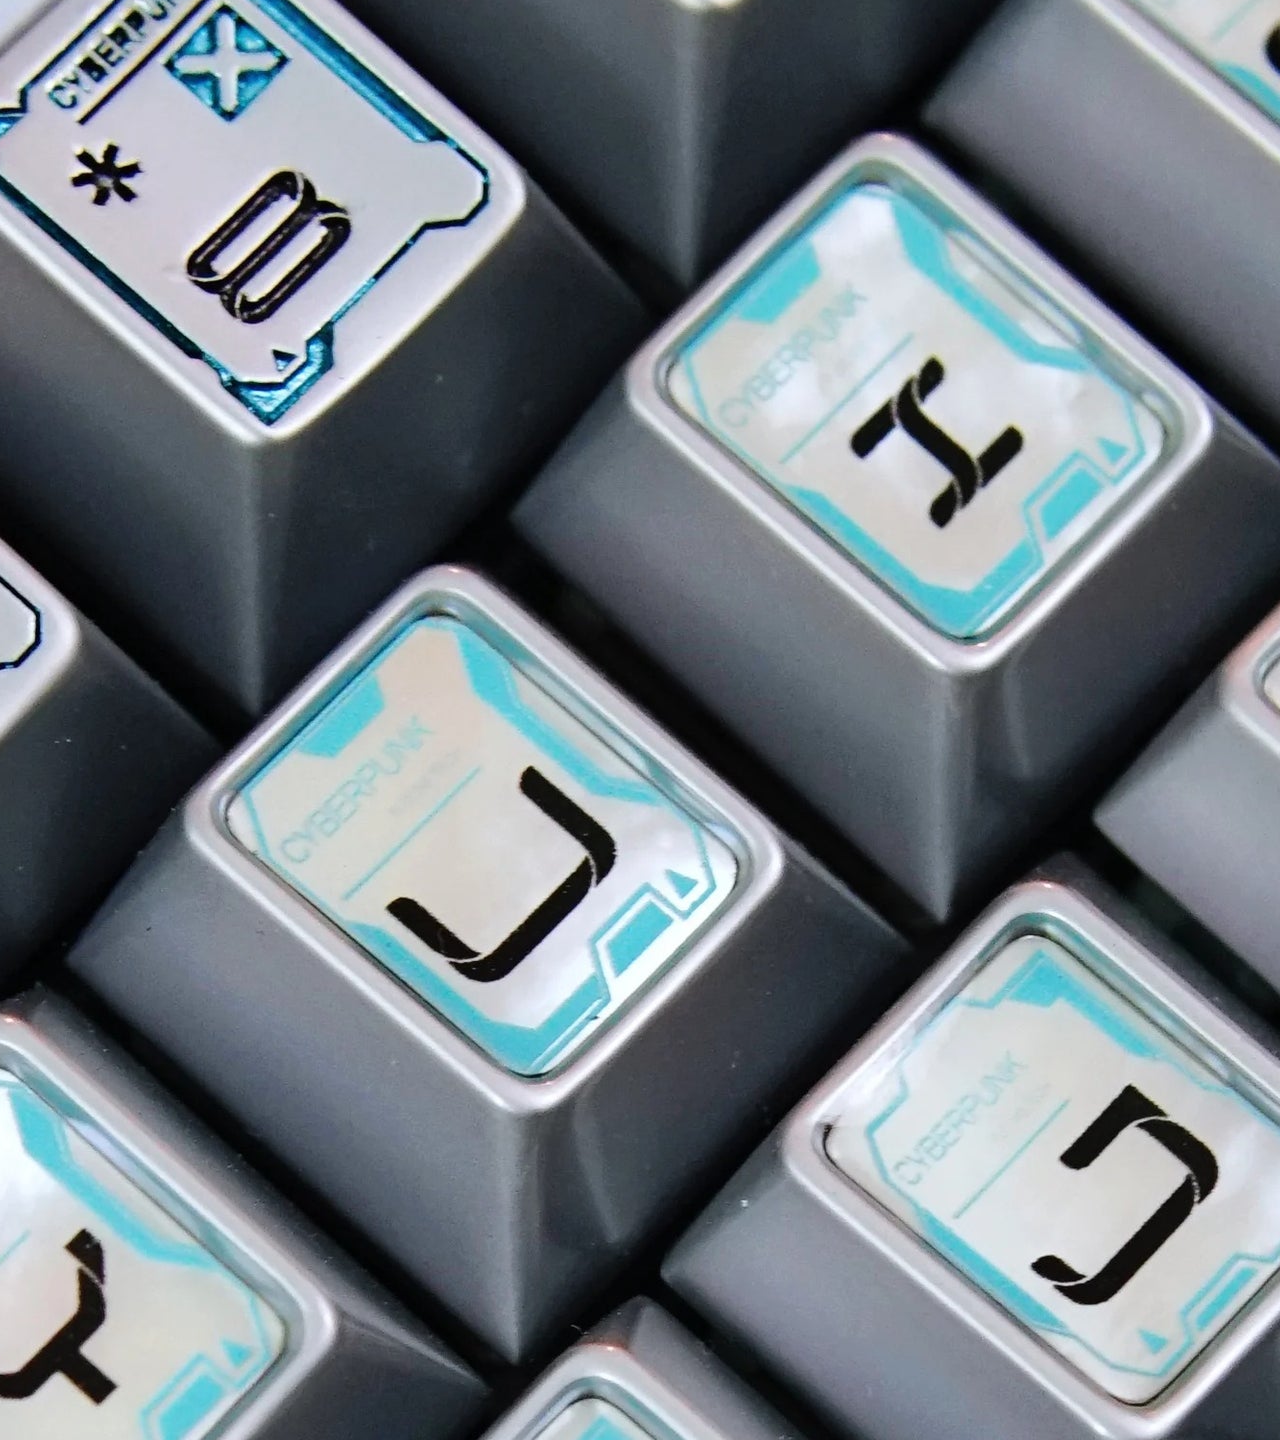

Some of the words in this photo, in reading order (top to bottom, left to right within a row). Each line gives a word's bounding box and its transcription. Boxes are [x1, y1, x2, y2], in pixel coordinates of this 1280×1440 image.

[185, 169, 353, 326] 8
[849, 355, 1026, 529] I
[384, 763, 618, 984] U
[1029, 1081, 1220, 1307] J
